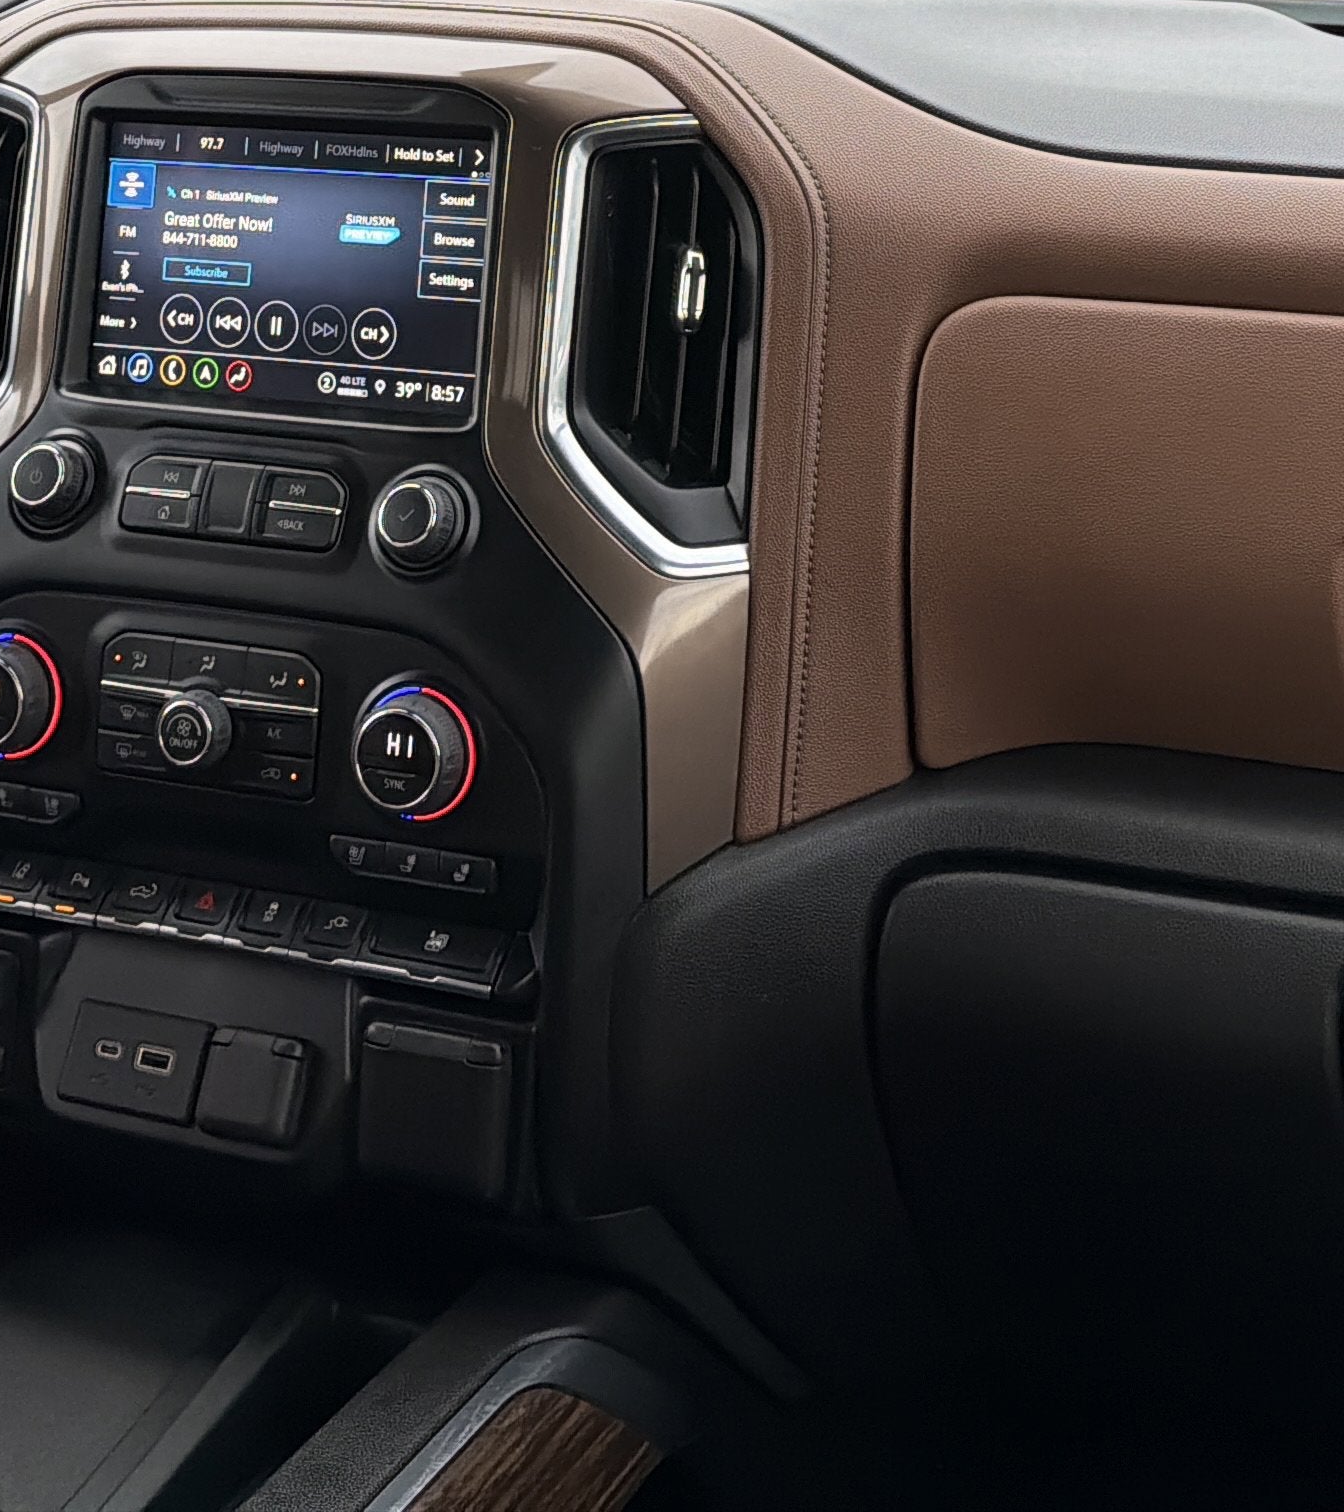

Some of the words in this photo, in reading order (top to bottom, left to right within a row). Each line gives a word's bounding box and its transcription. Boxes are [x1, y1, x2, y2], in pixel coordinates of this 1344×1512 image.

[123, 134, 166, 151] Highway
[200, 137, 225, 150] 97.7
[259, 141, 304, 157] Highway
[326, 144, 378, 159] FOXHdlns
[393, 147, 420, 162] Hold
[421, 149, 434, 162] to
[435, 150, 455, 164] Set
[180, 188, 193, 201] Ch
[206, 189, 243, 203] SiriusXM
[244, 192, 279, 206] Preview
[439, 192, 475, 208] Sound
[164, 211, 201, 228] Great
[202, 213, 236, 231] Offer
[238, 216, 274, 233] Now!
[345, 213, 396, 227] SIRIUSXM
[119, 224, 137, 239] FM
[162, 230, 239, 249] 844-711-8800
[433, 231, 475, 248] Browse
[184, 265, 229, 279] Subscribe
[428, 272, 475, 291] Settings
[99, 314, 125, 328] More
[177, 313, 194, 326] CH
[360, 327, 378, 341] CH
[351, 376, 367, 387] LTE
[394, 380, 423, 399] 39°
[431, 384, 465, 402] 8:57
[283, 519, 305, 532] BACK
[266, 727, 283, 741] A/C
[168, 736, 197, 750] ON/OFF
[386, 731, 414, 759] HI
[383, 777, 407, 792] SYNC
